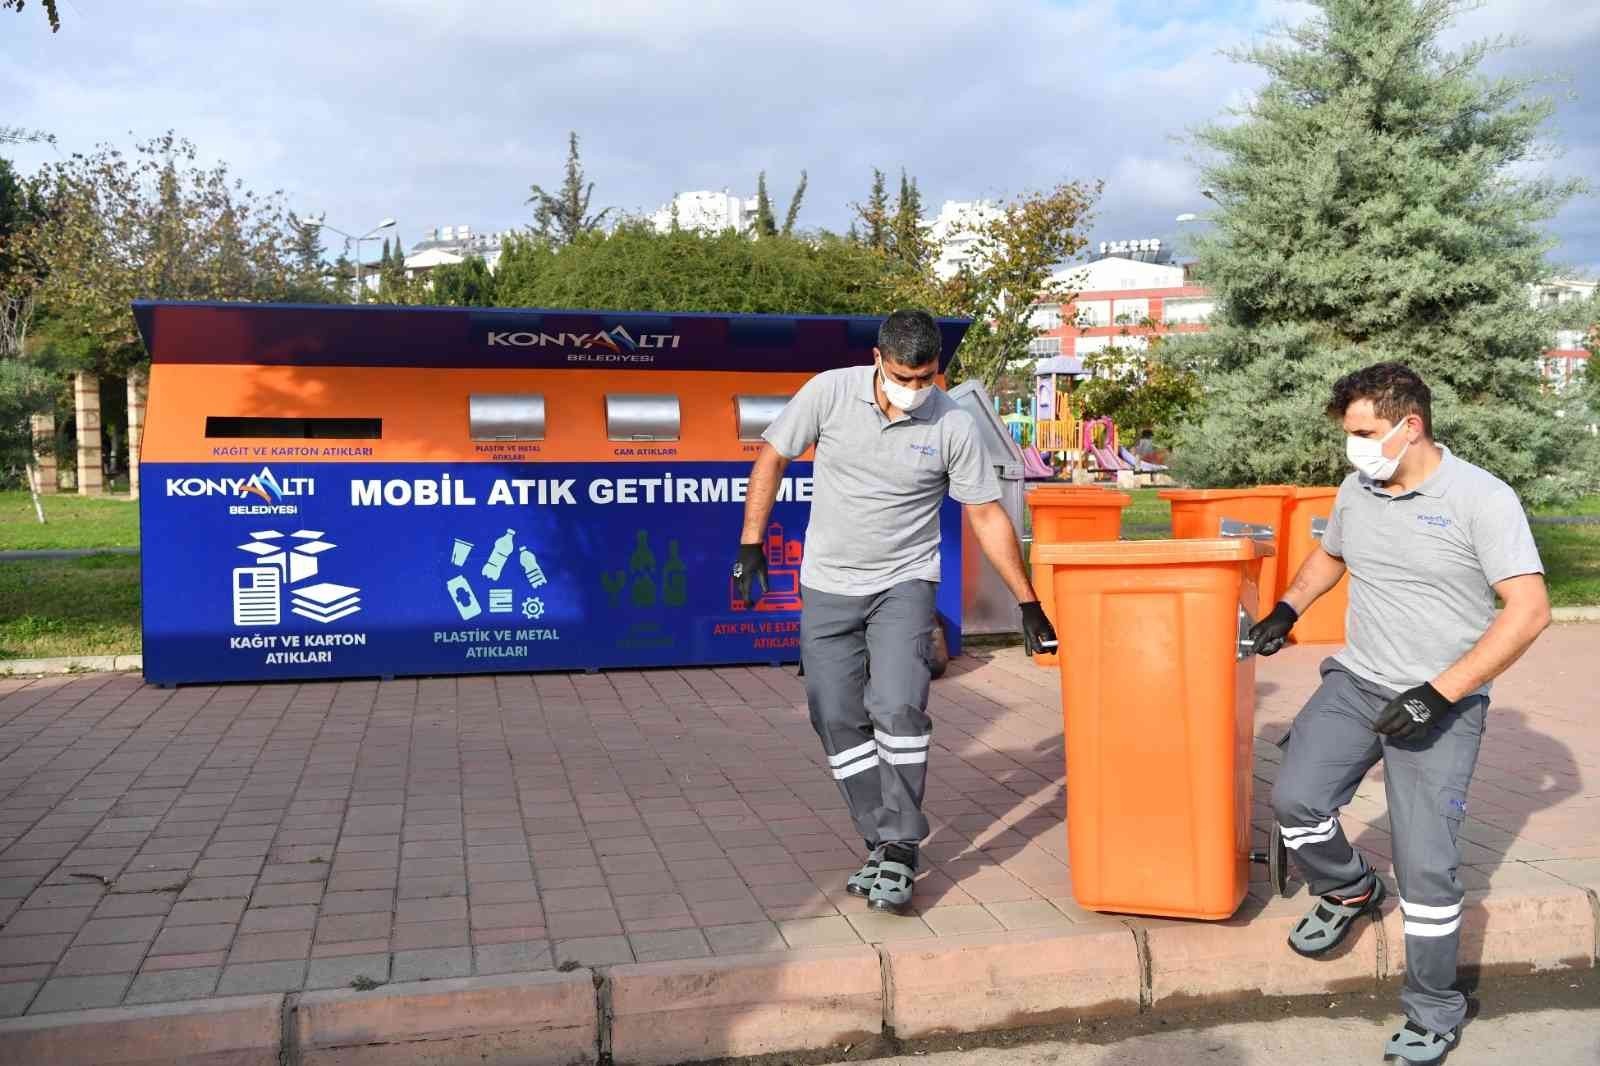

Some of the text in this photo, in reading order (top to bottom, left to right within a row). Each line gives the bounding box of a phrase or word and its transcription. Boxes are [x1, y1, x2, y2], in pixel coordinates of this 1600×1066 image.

[253, 447, 267, 456] VE
[271, 447, 319, 456] KARTON
[322, 447, 373, 456] ATIKLARI
[614, 448, 677, 456] CAM ATIKLARI
[350, 473, 476, 506] MOBİL
[487, 479, 577, 505] ATIK
[588, 472, 749, 505] GETİRME
[230, 633, 366, 649] KAĞIT VE KARTON
[433, 628, 560, 643] PLASTİK VE METAL
[265, 651, 332, 665] ATIKLARI
[465, 646, 528, 658] ATIKLARI
